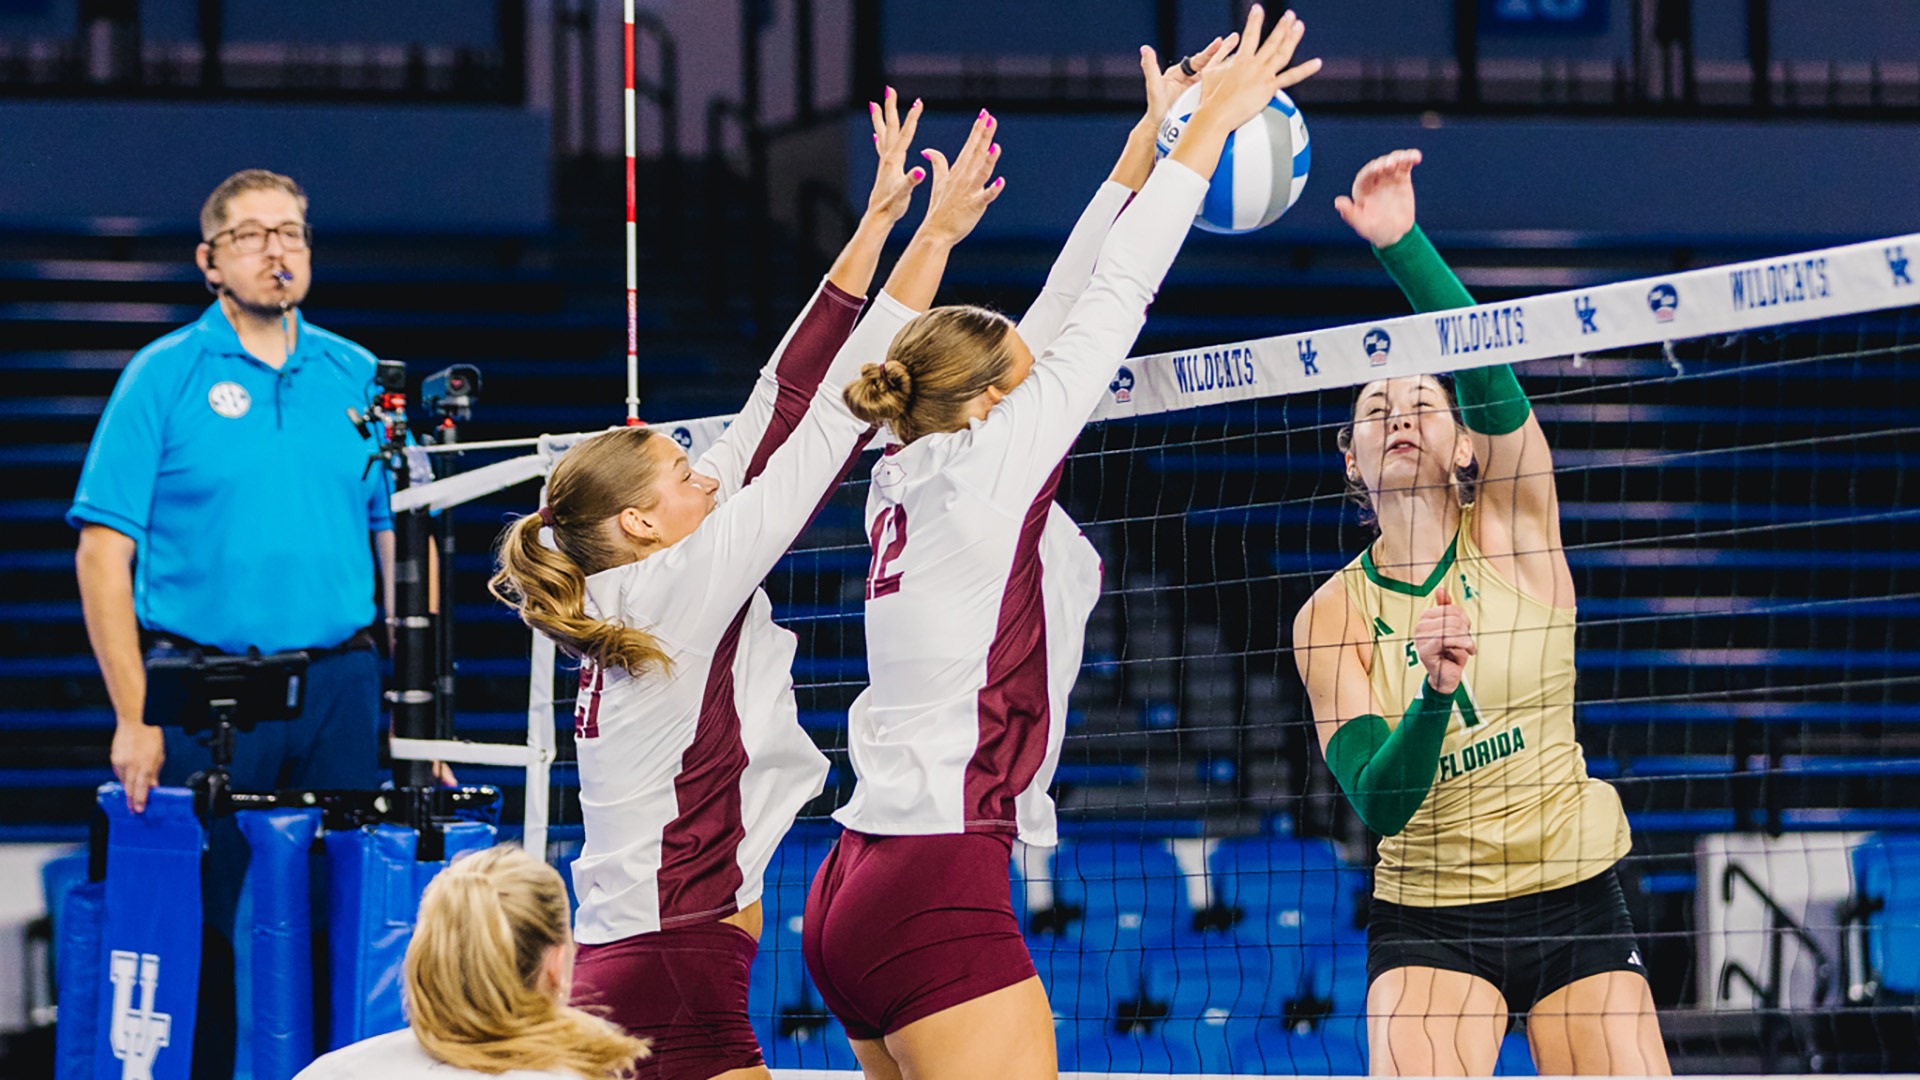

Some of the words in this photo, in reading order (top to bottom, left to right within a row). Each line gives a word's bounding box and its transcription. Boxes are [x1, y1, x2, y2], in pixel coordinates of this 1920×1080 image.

[1173, 347, 1254, 393] WILDCATS
[1435, 306, 1525, 356] WILDCATS
[1729, 257, 1830, 311] WILDCATS
[865, 503, 905, 601] 12
[1439, 726, 1526, 782] FLORIDA
